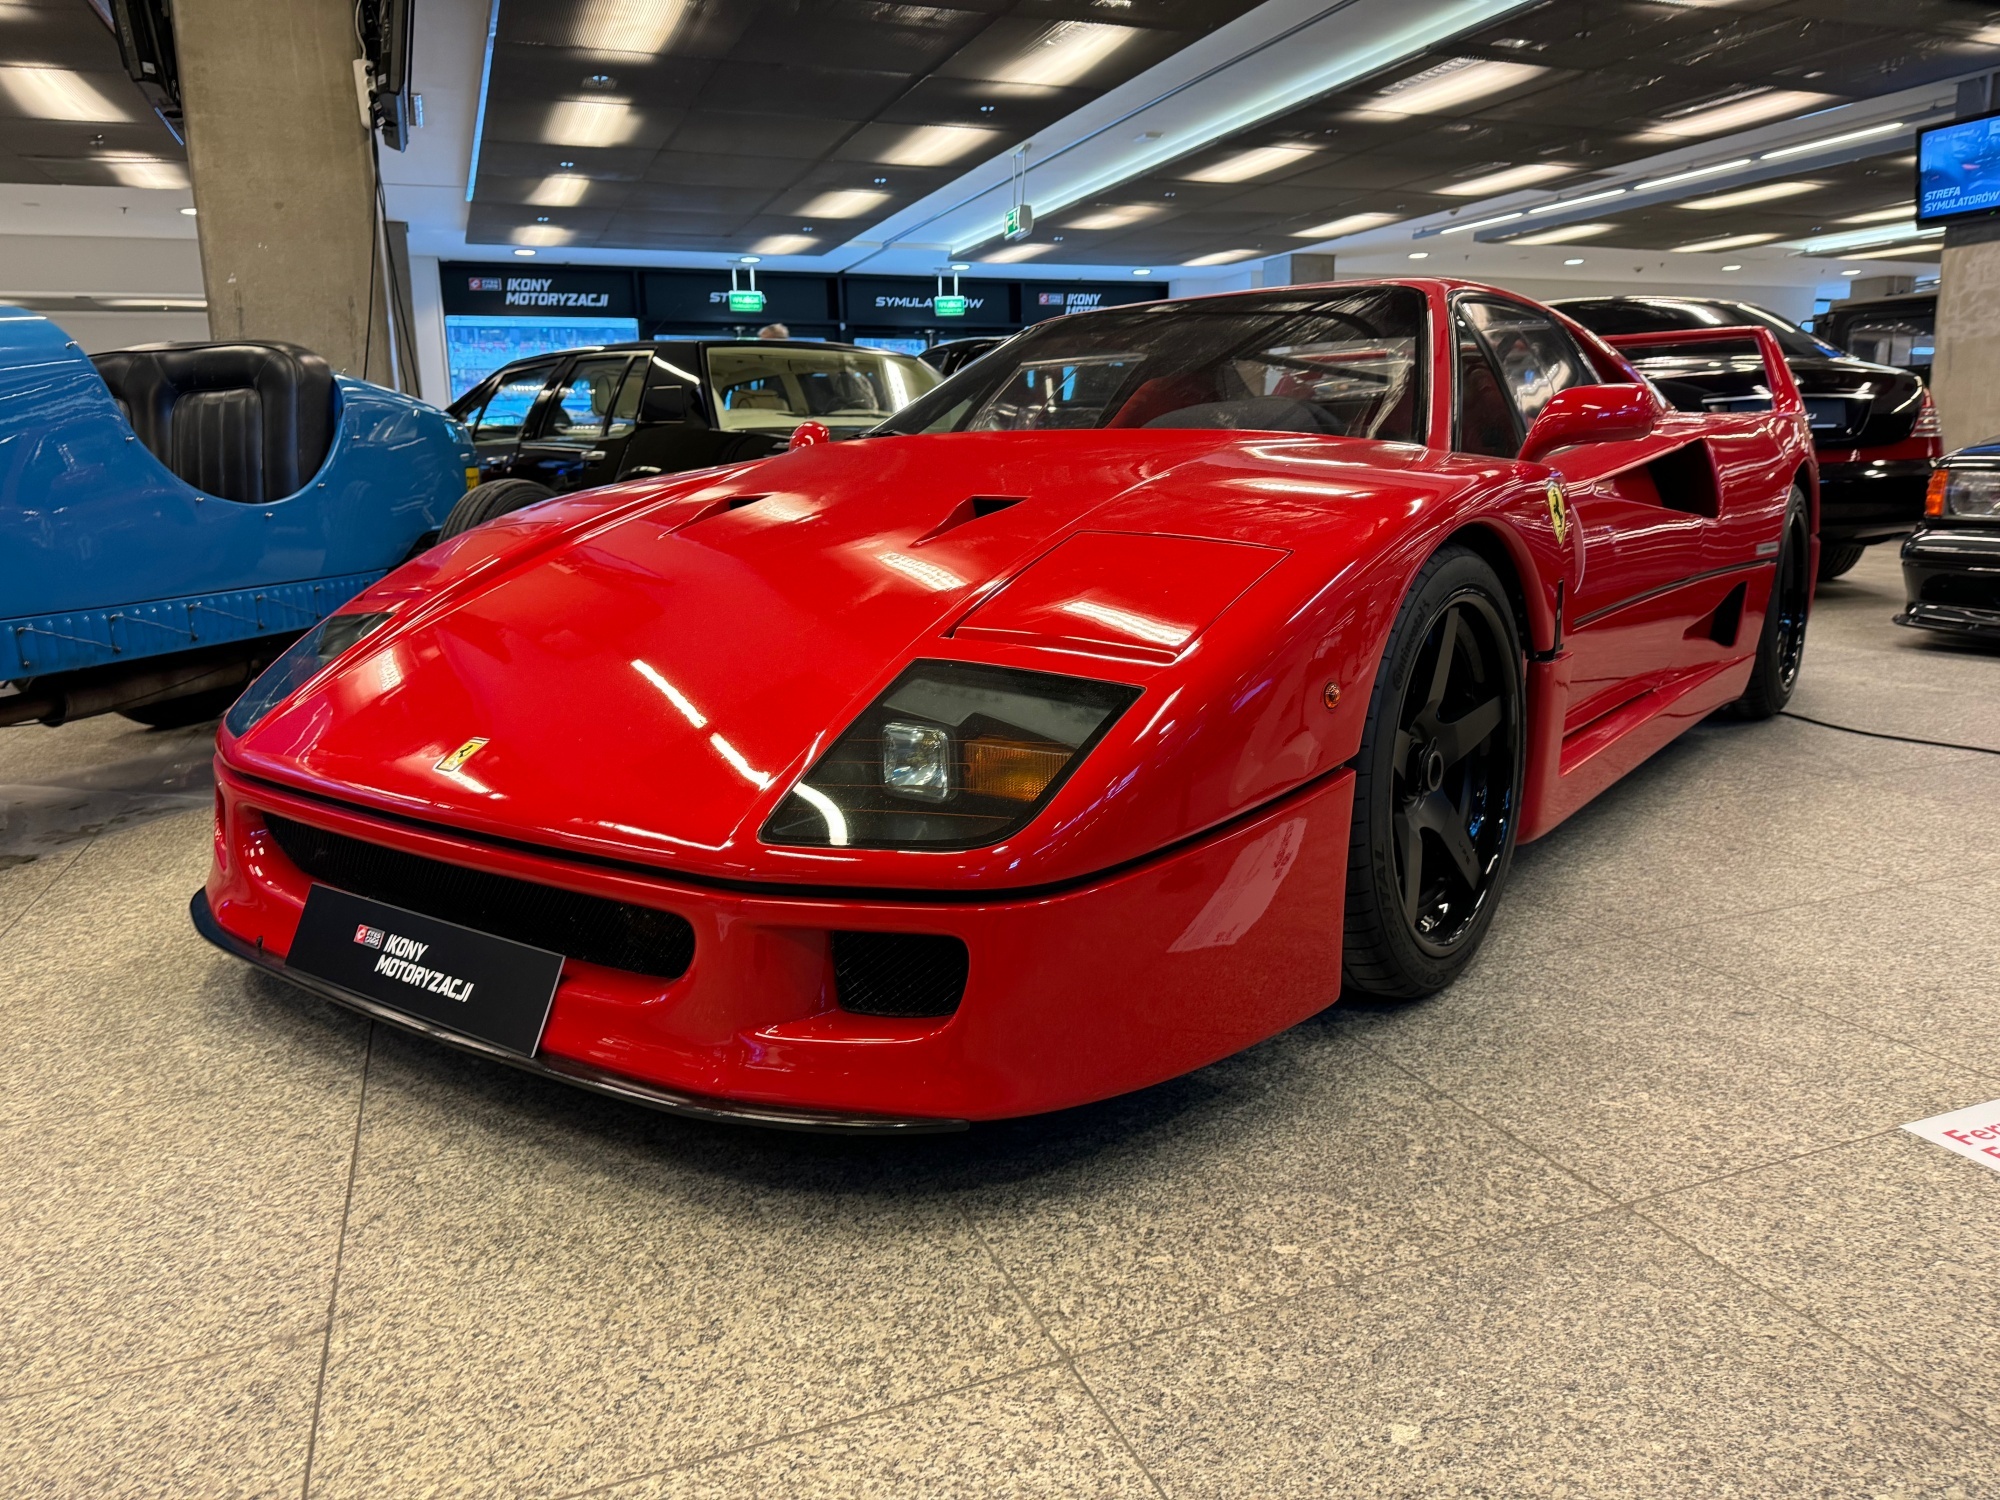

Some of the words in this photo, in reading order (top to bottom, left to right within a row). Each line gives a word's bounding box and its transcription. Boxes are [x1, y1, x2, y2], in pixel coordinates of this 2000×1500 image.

[1923, 190, 2000, 213] SYMULATORÓW
[1924, 186, 1961, 202] STREFA
[506, 278, 553, 292] IKONY
[505, 292, 609, 307] MOTORYZACJI
[1066, 293, 1102, 305] IKONY
[383, 933, 429, 962] IKONY
[374, 954, 475, 1002] MOTORYZACJI
[1942, 1123, 2000, 1145] Fer
